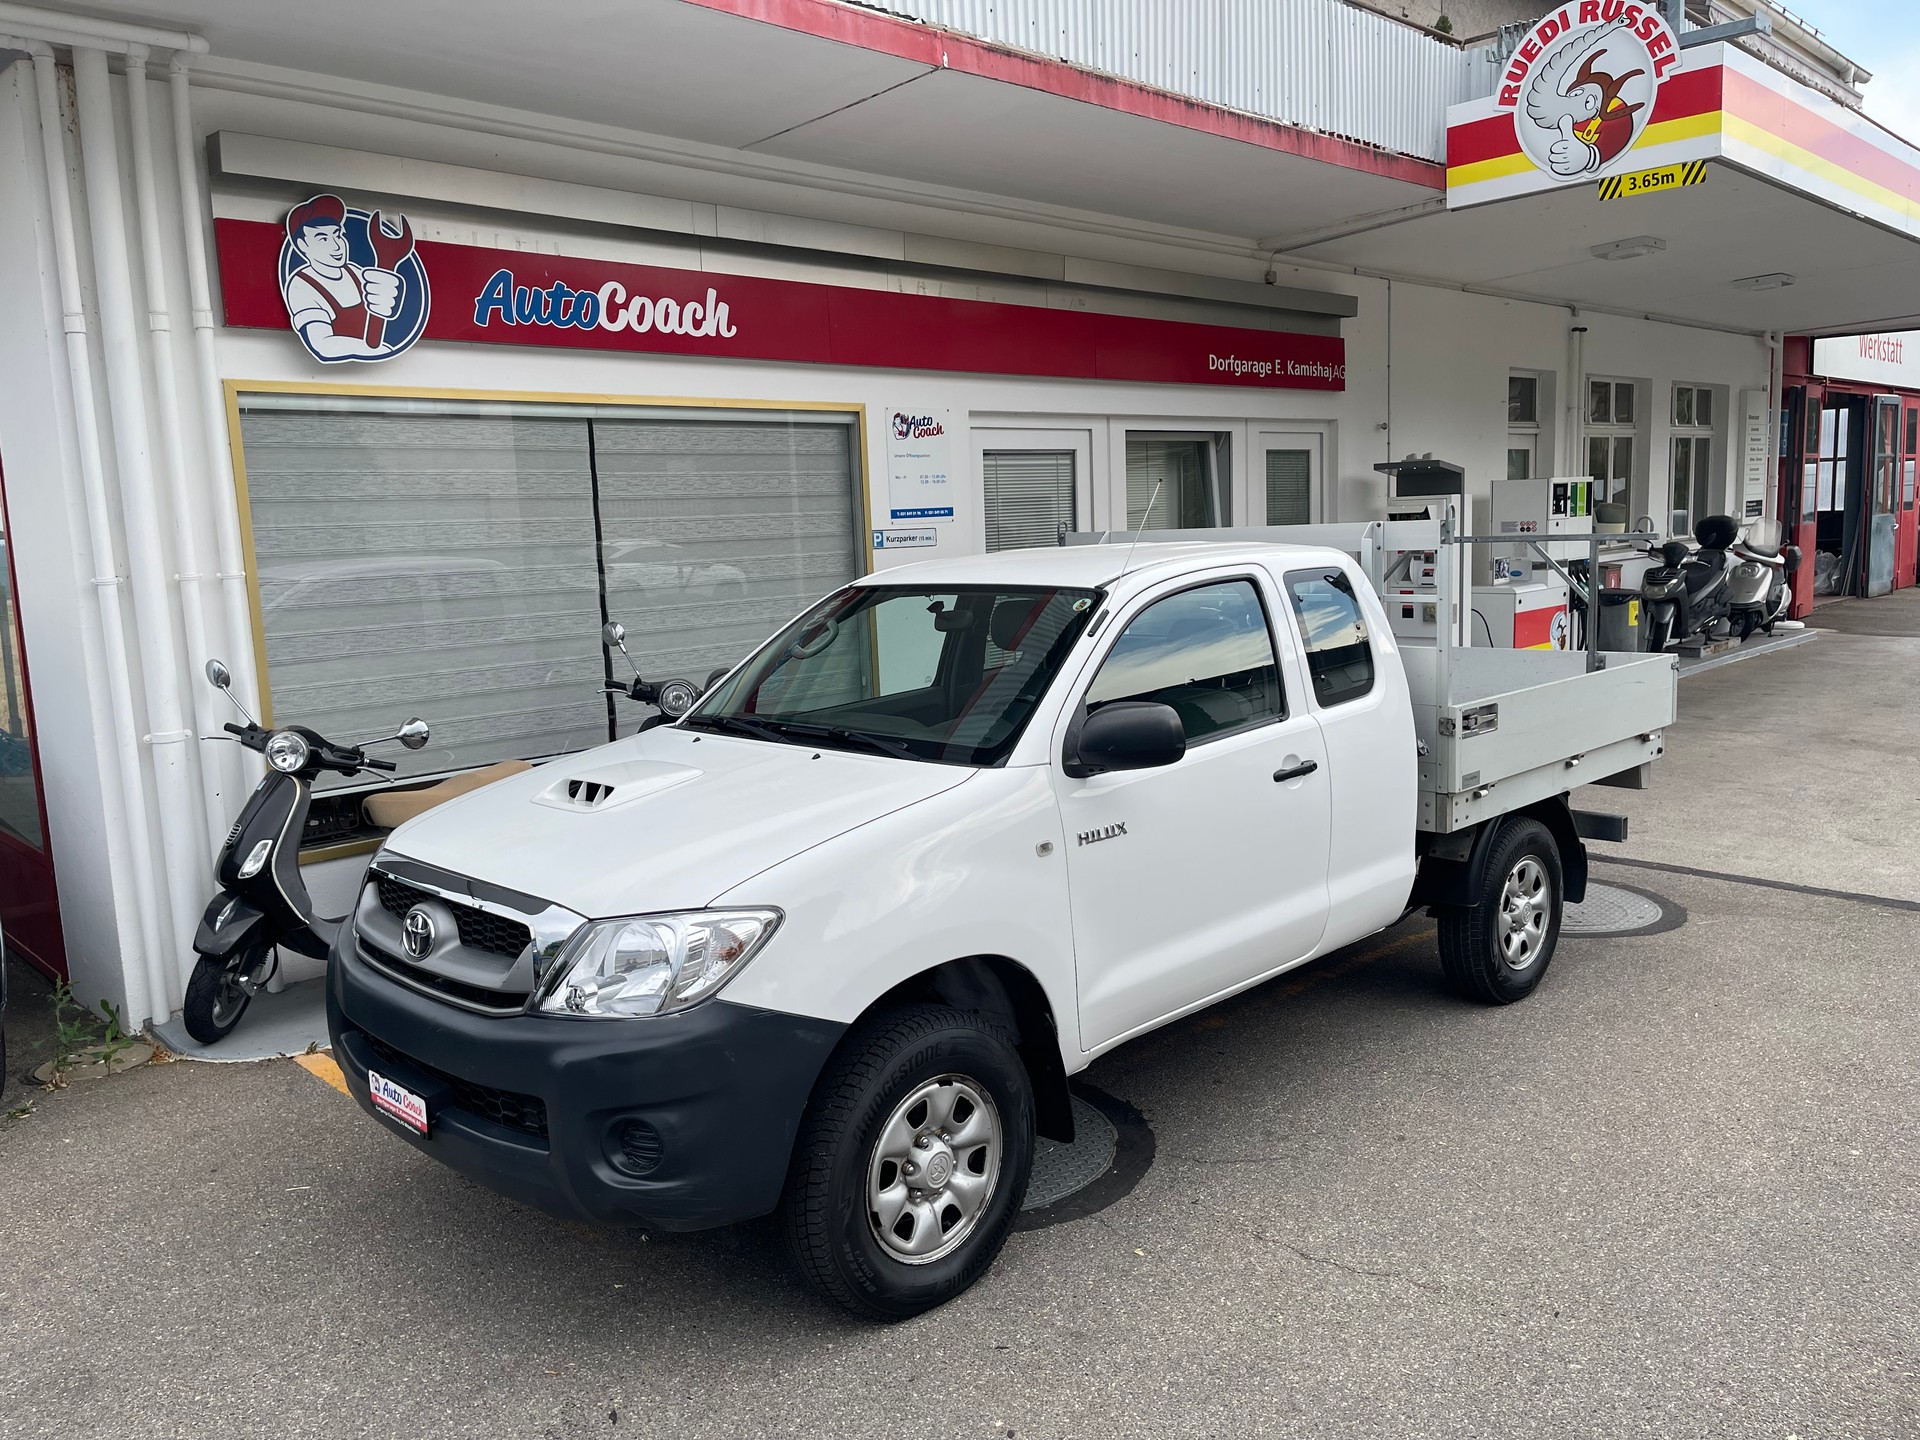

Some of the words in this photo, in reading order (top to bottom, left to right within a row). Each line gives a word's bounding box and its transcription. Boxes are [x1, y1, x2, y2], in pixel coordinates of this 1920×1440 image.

[1499, 10, 1571, 107] RUEDI
[1579, 0, 1676, 78] RUSSEL
[1628, 172, 1675, 191] 3.65m
[474, 269, 737, 338] AutoCoach
[1860, 334, 1902, 364] Werkstatt
[1209, 354, 1272, 377] Dorfgarage
[1275, 359, 1284, 375] E.
[1287, 360, 1333, 381] Kamishaj
[910, 415, 933, 427] Auto
[913, 422, 944, 438] Coach
[886, 535, 917, 543] Kurzparker
[1077, 821, 1128, 847] HILUX
[382, 1081, 402, 1105] Auto
